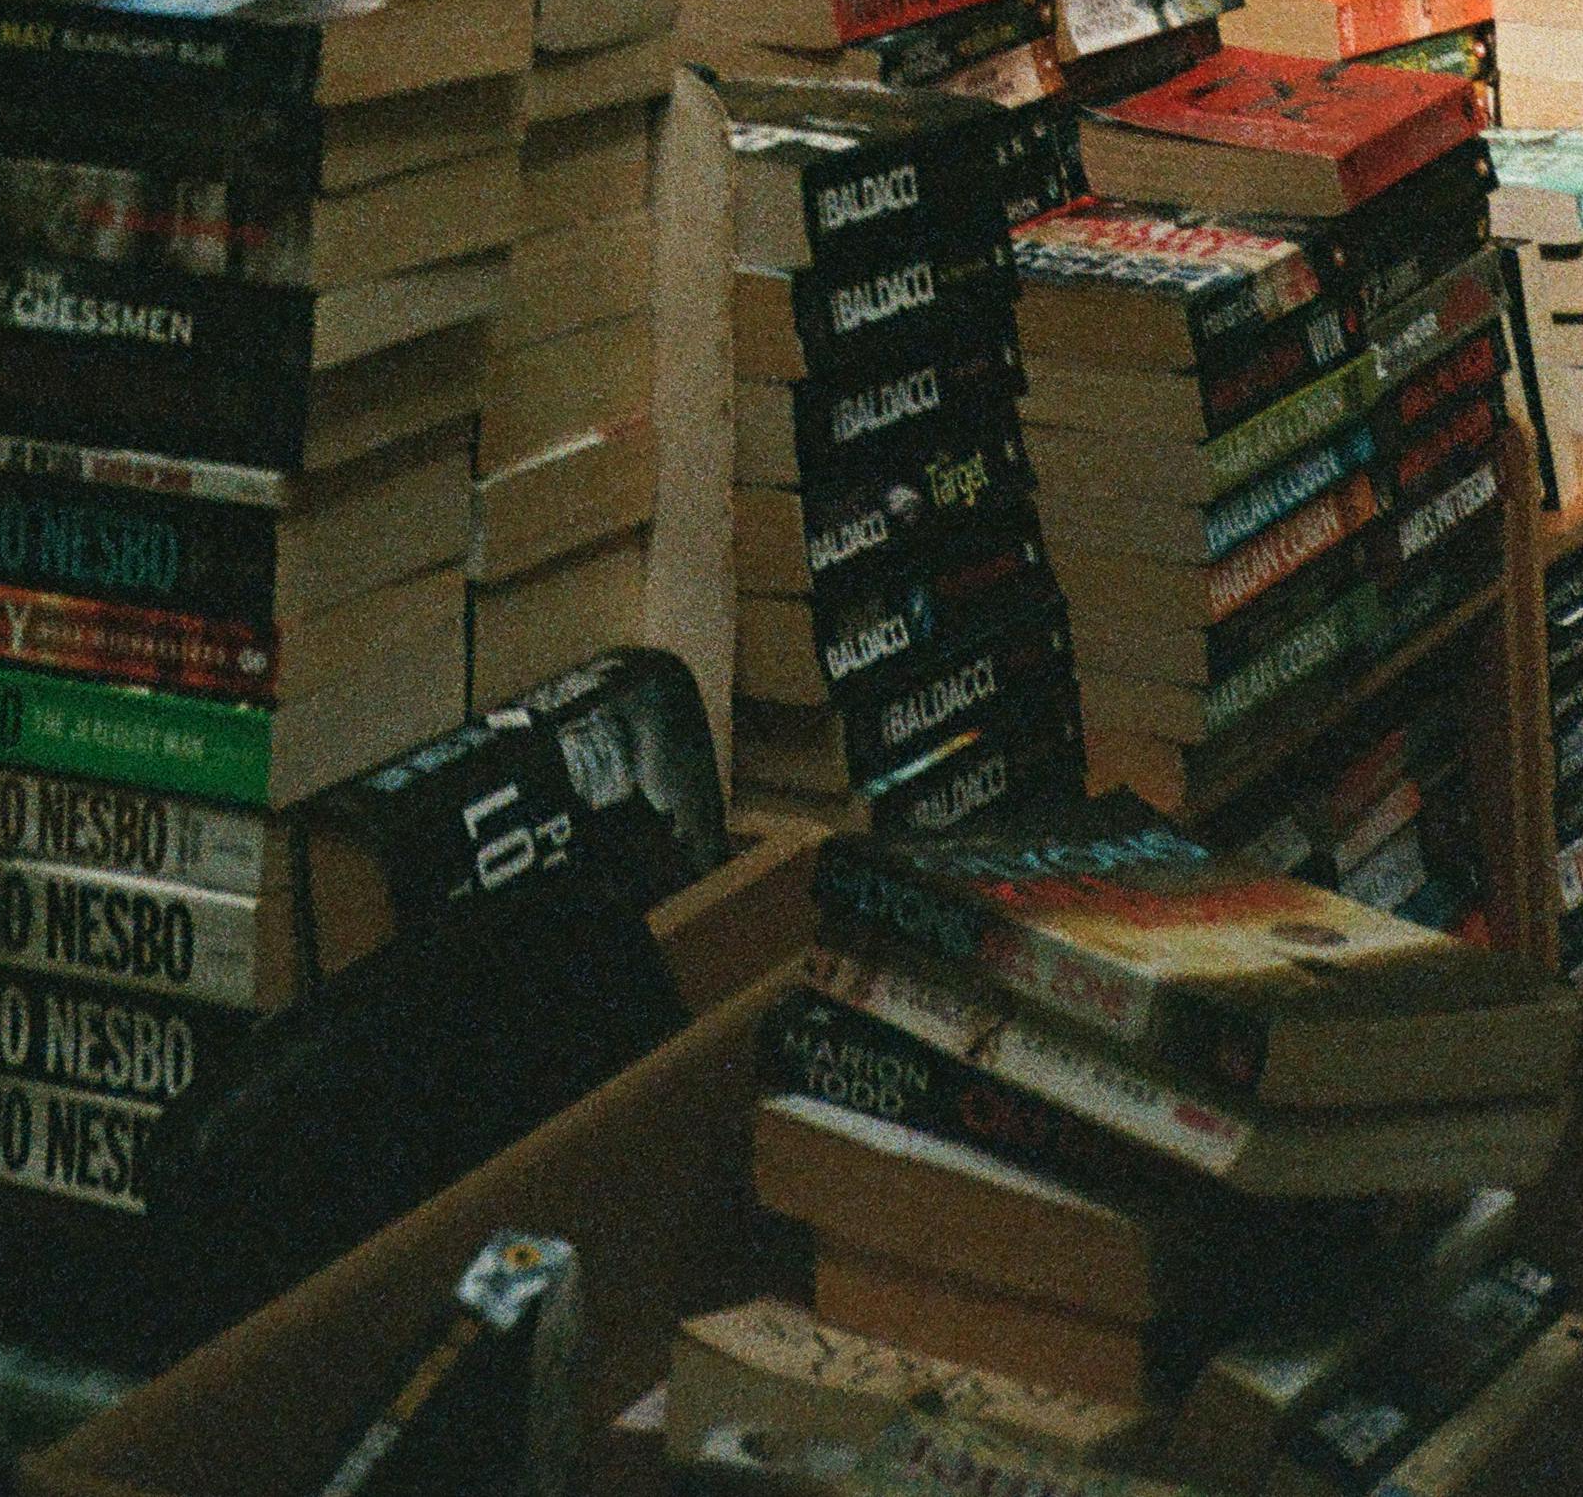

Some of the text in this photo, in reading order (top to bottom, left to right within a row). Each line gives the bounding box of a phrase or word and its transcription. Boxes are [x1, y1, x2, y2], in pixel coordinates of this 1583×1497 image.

[12, 291, 195, 346] CHESSMEN
[924, 451, 990, 508] Target
[824, 613, 911, 681] BALDACCI
[36, 779, 170, 874] NESBO
[43, 878, 195, 982] NESBO
[43, 993, 196, 1099] NESBO
[784, 1028, 930, 1092] MARION
[803, 1067, 906, 1118] TODD
